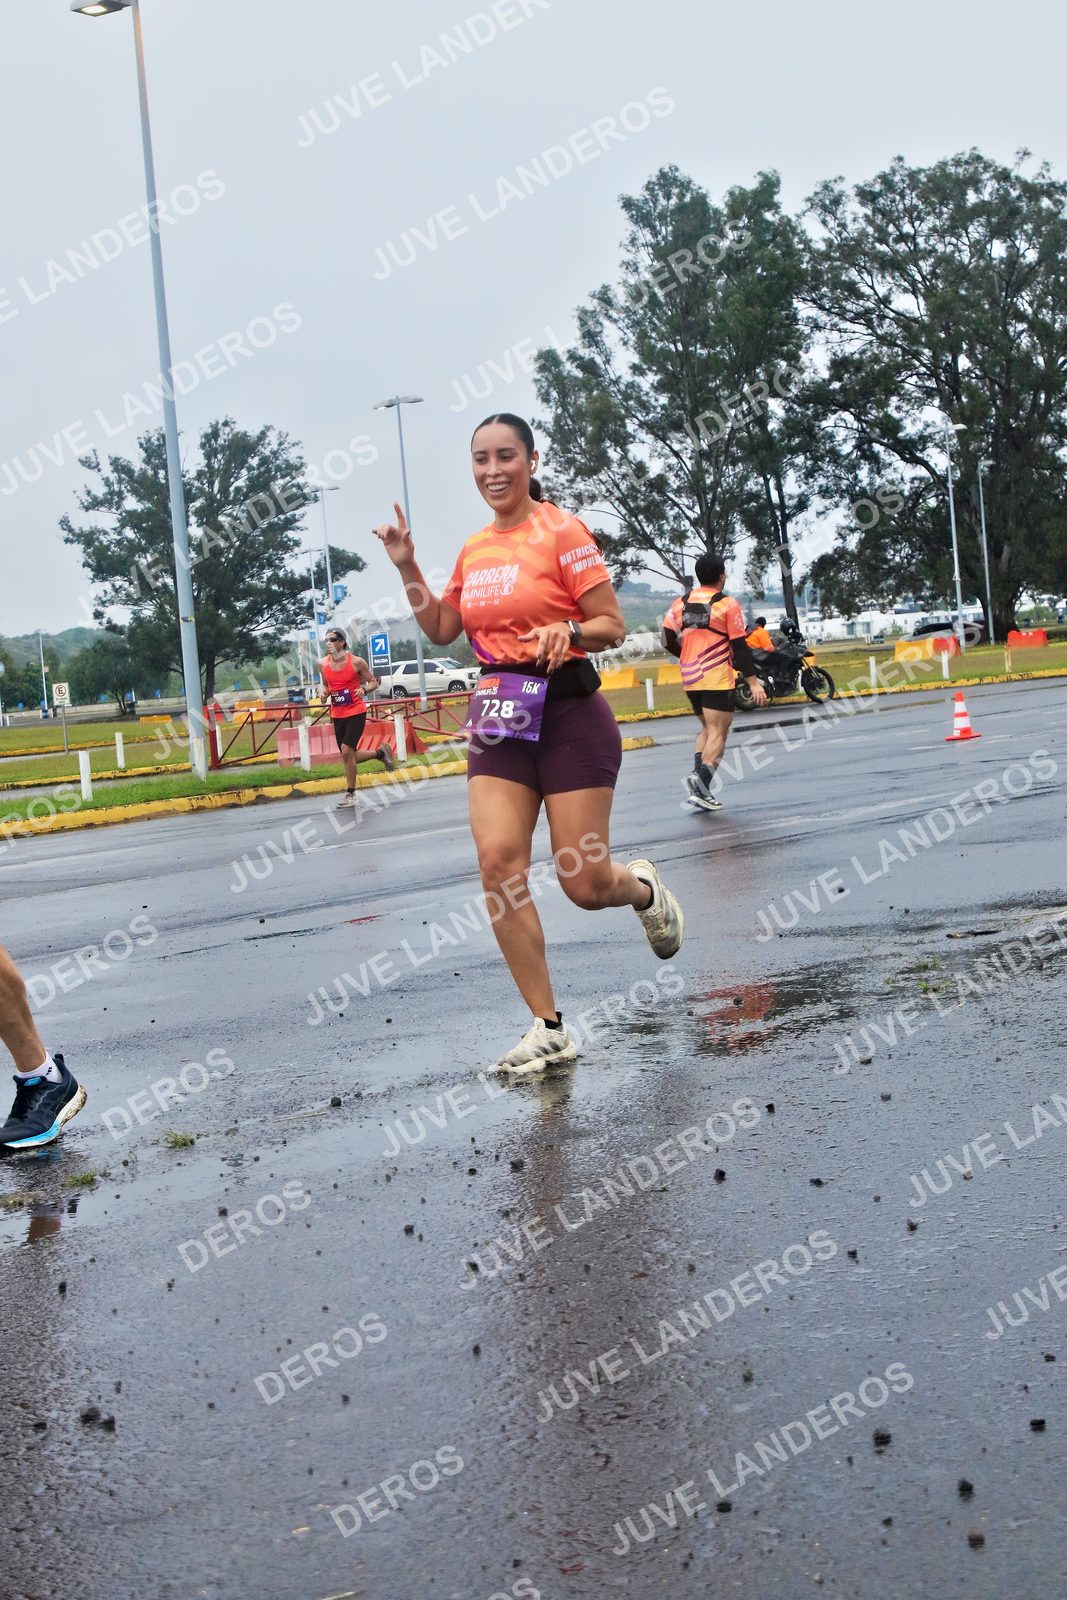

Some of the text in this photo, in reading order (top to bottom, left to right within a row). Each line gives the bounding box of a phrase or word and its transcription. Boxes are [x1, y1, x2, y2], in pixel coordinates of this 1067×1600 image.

[463, 564, 520, 589] CARRERA
[461, 584, 500, 602] OMNILIFE
[481, 699, 515, 719] 728
